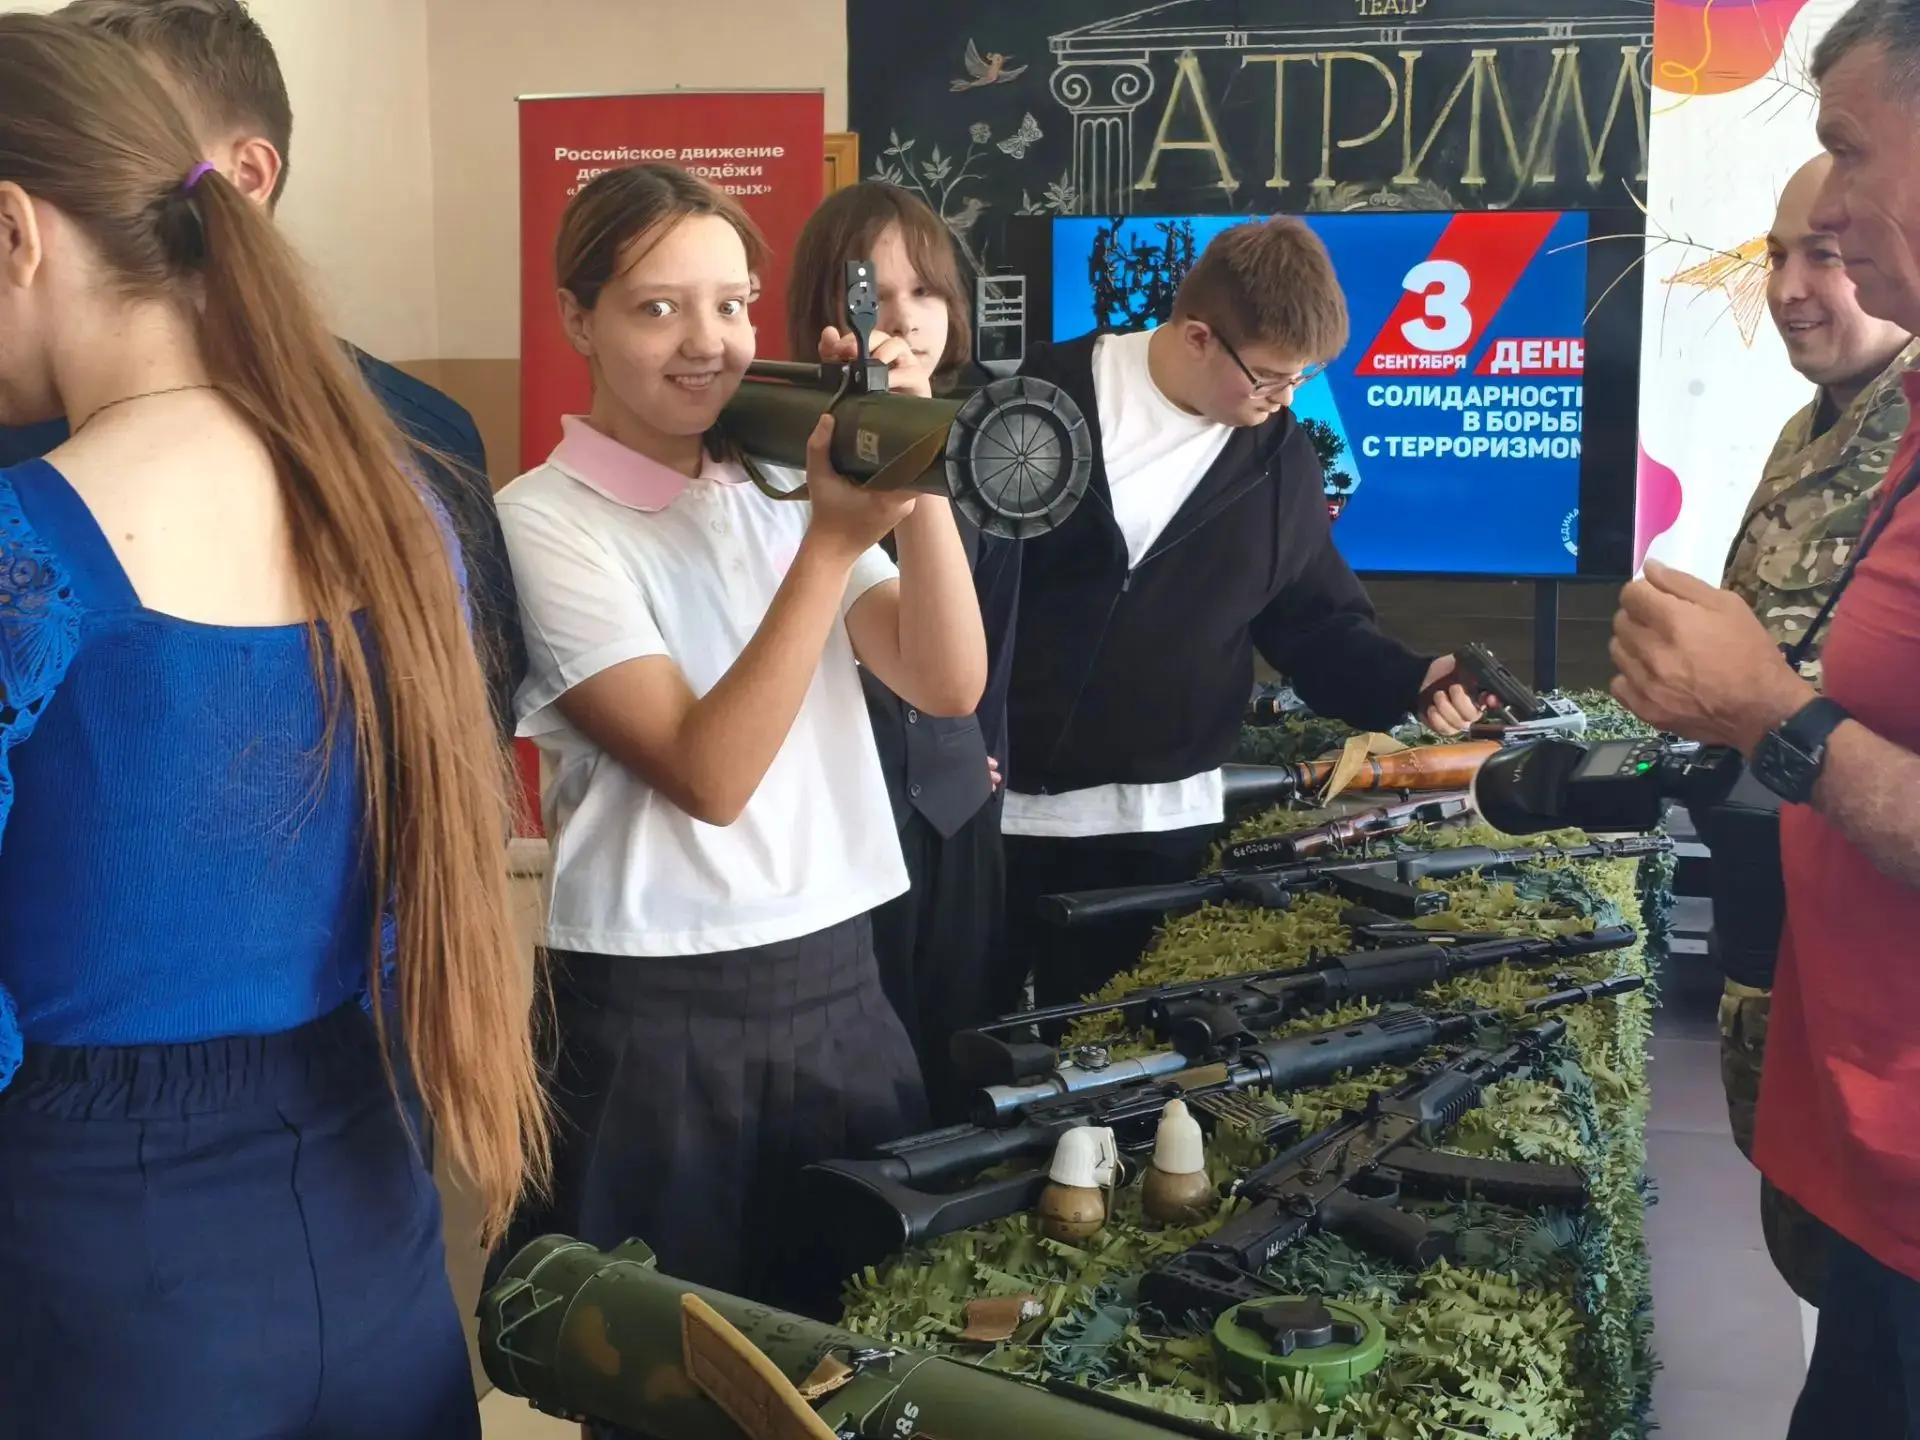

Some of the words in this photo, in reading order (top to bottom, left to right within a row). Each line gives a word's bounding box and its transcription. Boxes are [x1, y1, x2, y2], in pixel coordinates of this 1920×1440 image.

[554, 146, 676, 162] Российское
[680, 145, 784, 161] движение
[1401, 260, 1473, 352] 3
[1373, 354, 1467, 369] СЕНТЯБРЯ
[1463, 411, 1480, 432] В
[1487, 411, 1582, 432] БОРЬБ
[1362, 435, 1380, 457] С
